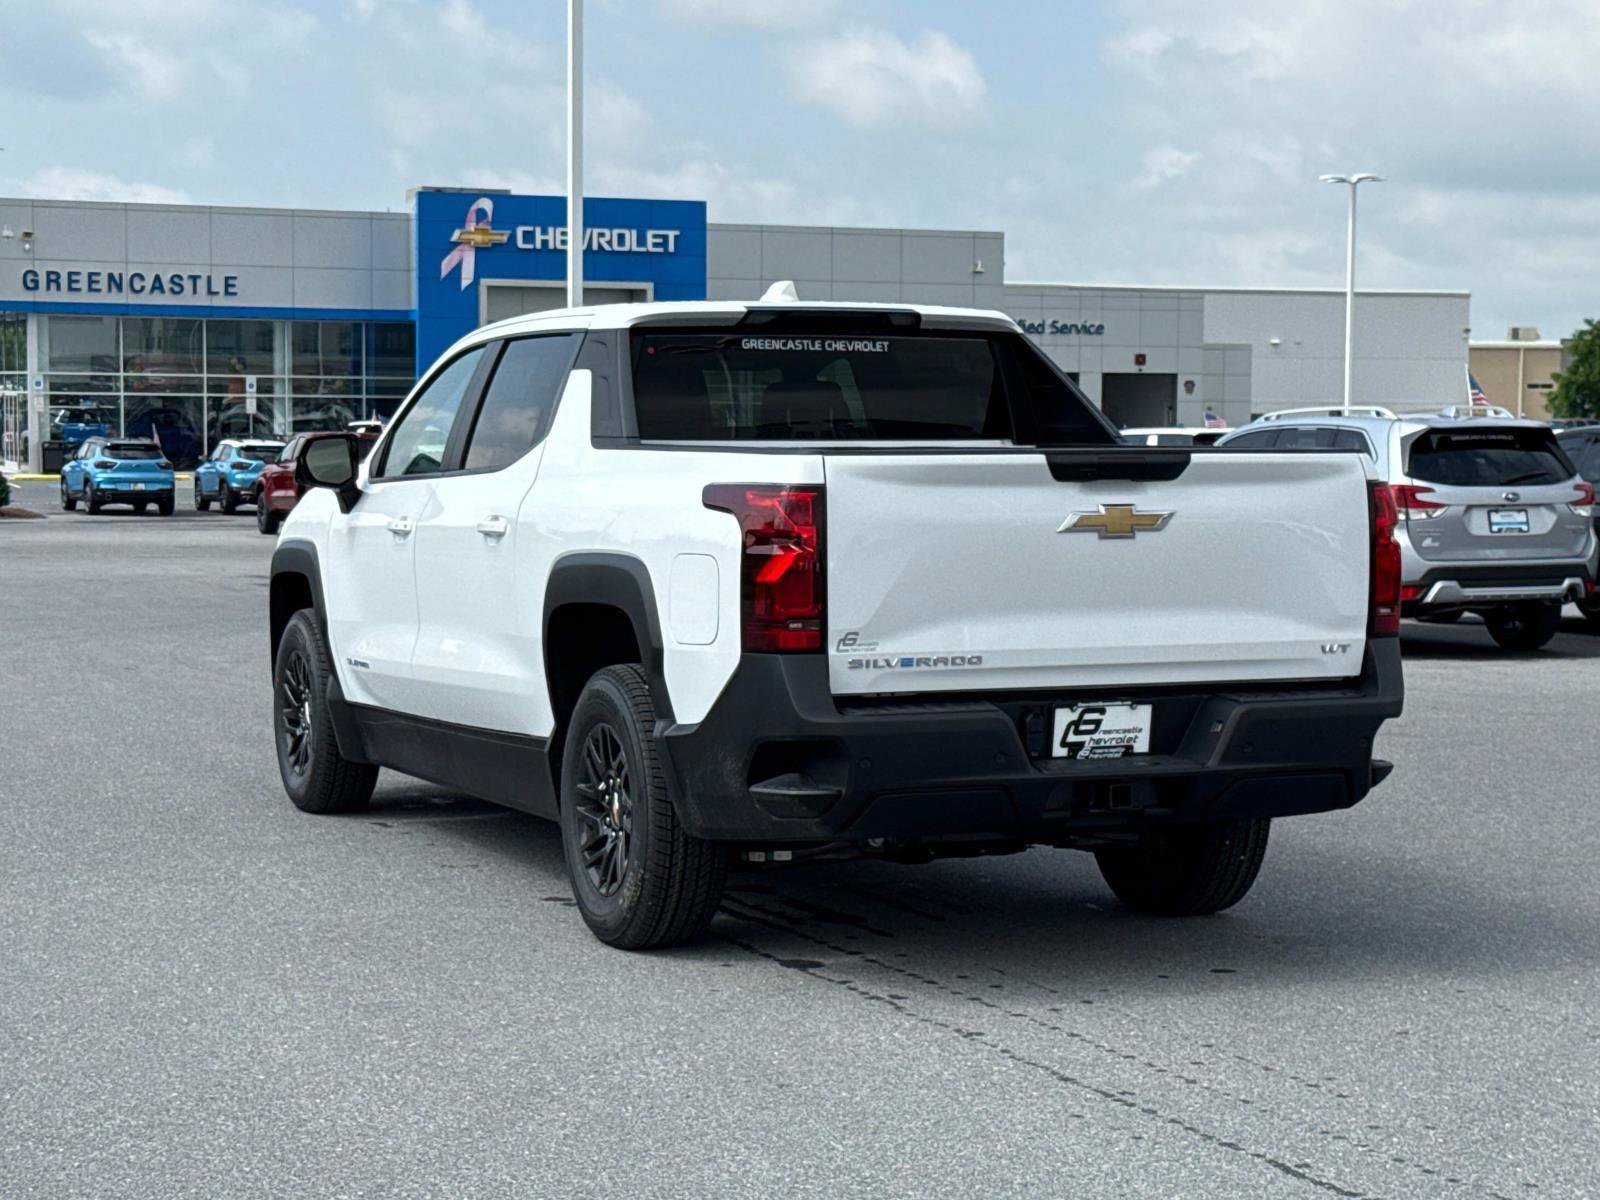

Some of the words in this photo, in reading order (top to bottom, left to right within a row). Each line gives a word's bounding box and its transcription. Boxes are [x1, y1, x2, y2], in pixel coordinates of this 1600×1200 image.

[22, 269, 238, 296] GREENCASTLE
[1050, 320, 1105, 335] Service
[741, 338, 822, 351] GREENCASTLE
[825, 340, 889, 352] CHEVROLET
[1320, 643, 1351, 655] WT
[848, 656, 983, 669] SILVERADO
